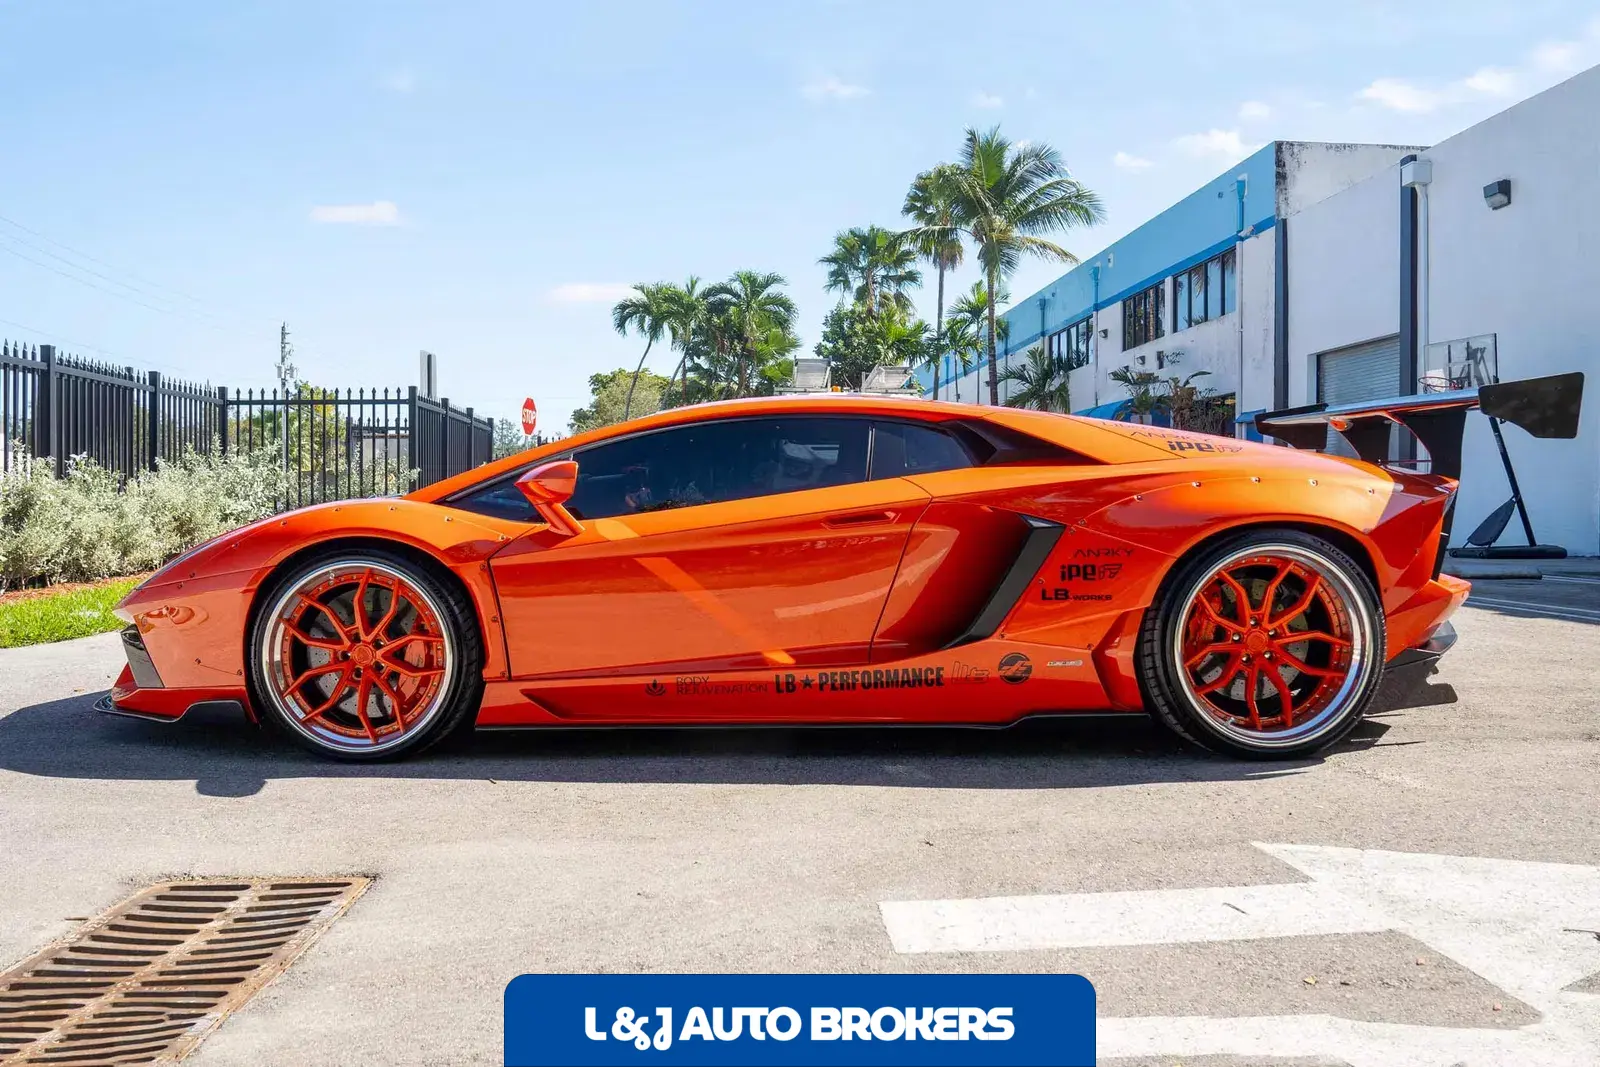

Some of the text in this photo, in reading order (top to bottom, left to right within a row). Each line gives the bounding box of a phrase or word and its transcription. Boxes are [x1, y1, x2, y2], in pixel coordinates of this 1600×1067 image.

[522, 408, 537, 425] STOP
[1041, 588, 1069, 601] LB
[676, 676, 710, 685] BODY
[775, 673, 797, 694] LB
[818, 667, 944, 692] PERFORMANCE
